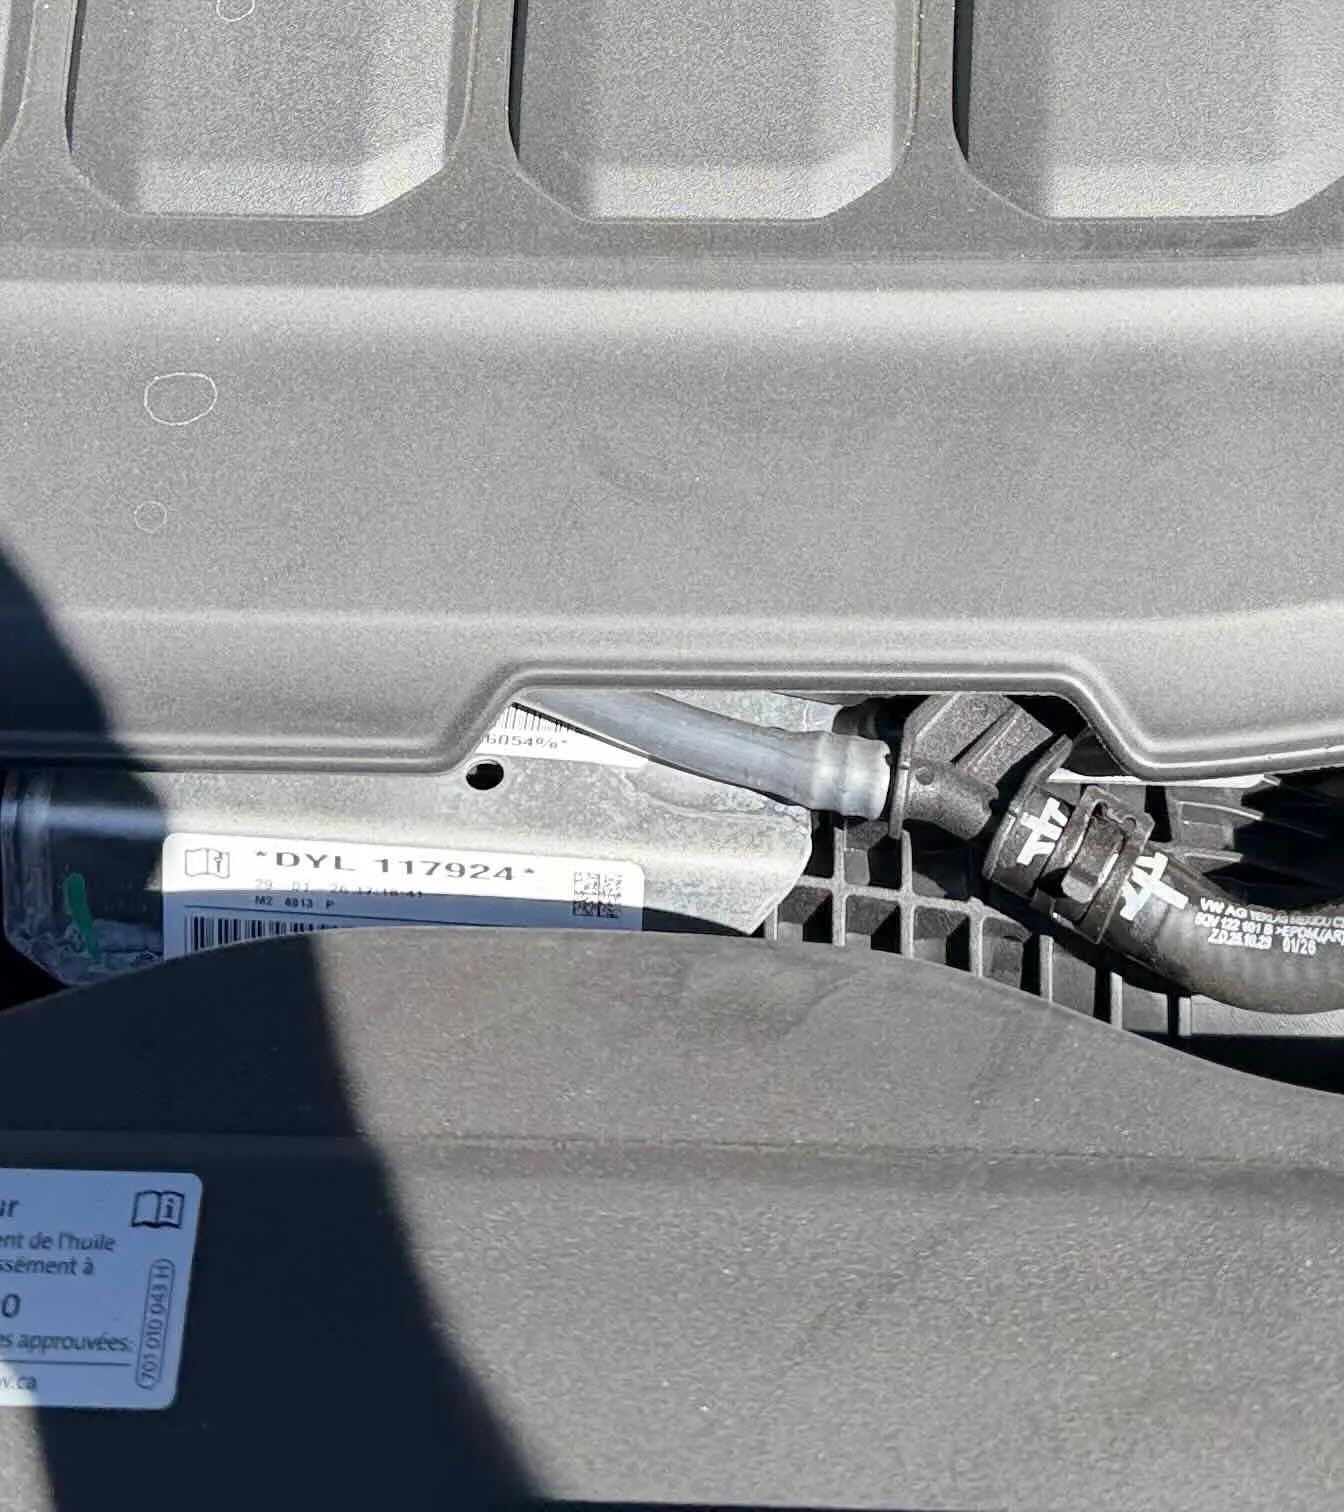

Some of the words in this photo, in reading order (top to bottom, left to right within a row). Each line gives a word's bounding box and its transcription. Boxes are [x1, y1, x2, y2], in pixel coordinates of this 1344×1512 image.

[1200, 897, 1224, 914] VW
[1224, 904, 1248, 919] AG
[29, 1231, 54, 1250] de
[58, 1231, 118, 1252] l'huile
[82, 1256, 95, 1276] à
